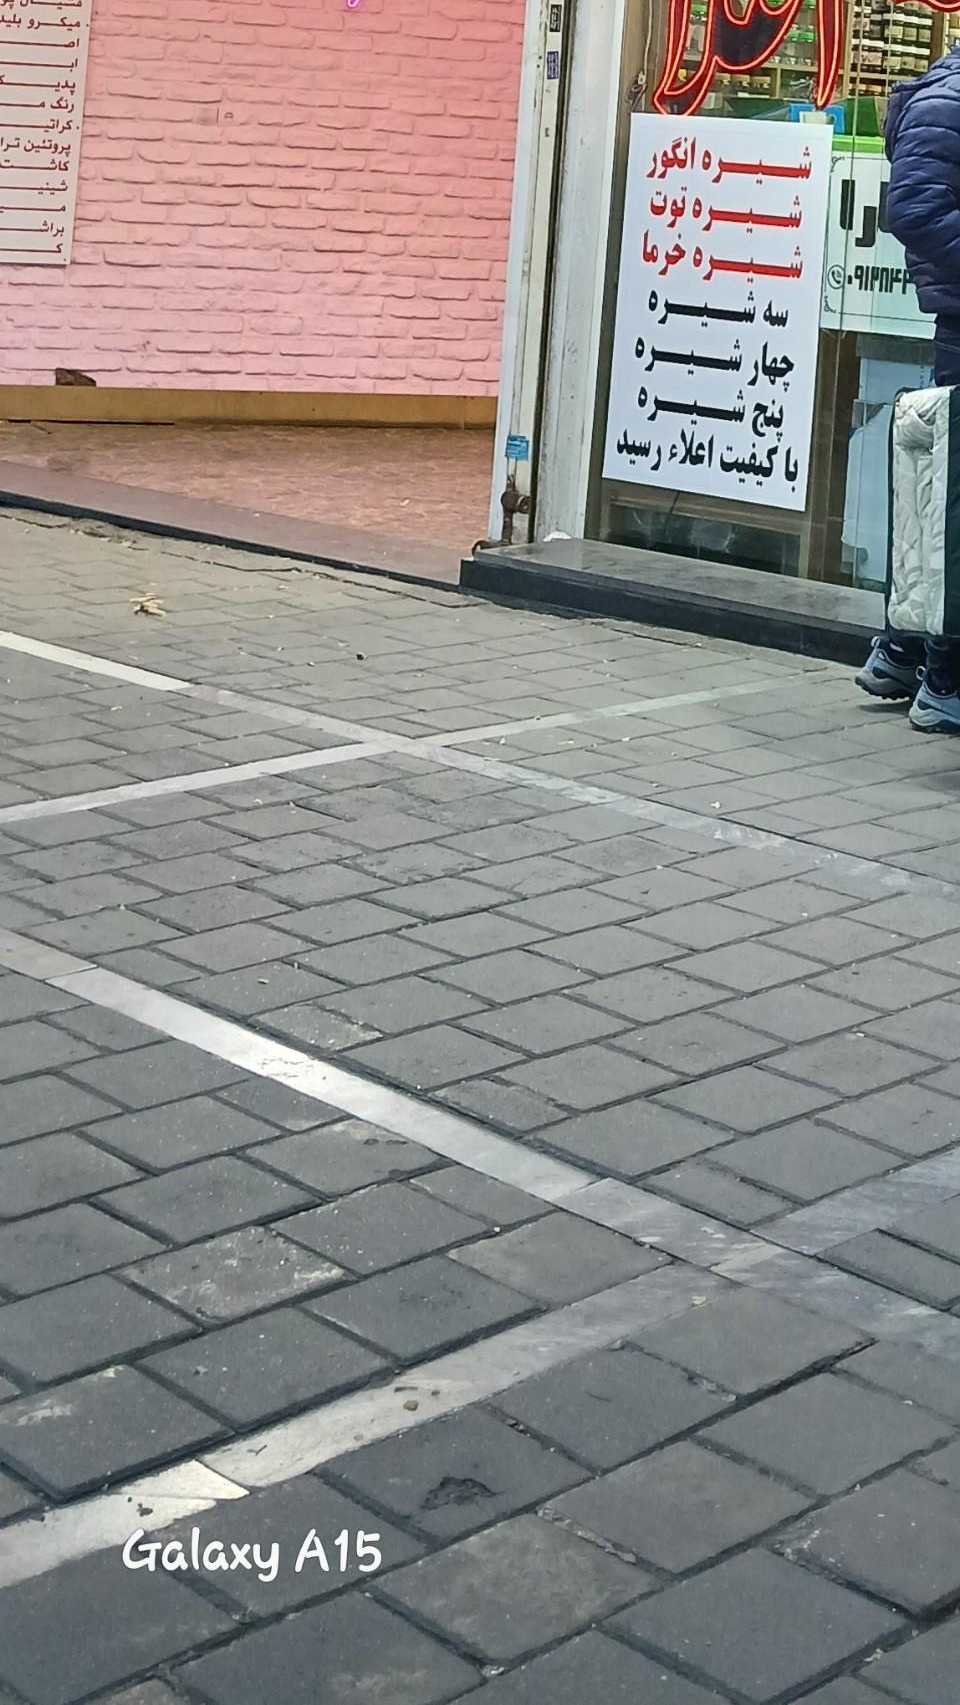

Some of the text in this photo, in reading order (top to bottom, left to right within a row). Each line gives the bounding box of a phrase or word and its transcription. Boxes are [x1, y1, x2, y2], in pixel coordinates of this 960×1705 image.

[646, 136, 812, 185] شیره انگور
[649, 185, 802, 234] شیره توت
[641, 230, 804, 283] شیره خرما
[648, 290, 789, 328] سه شیره
[635, 336, 795, 392] چهار شیره
[637, 386, 785, 440] پنج شیره
[616, 429, 662, 471] رسید
[719, 442, 779, 486] کیفیت
[784, 448, 799, 492] با
